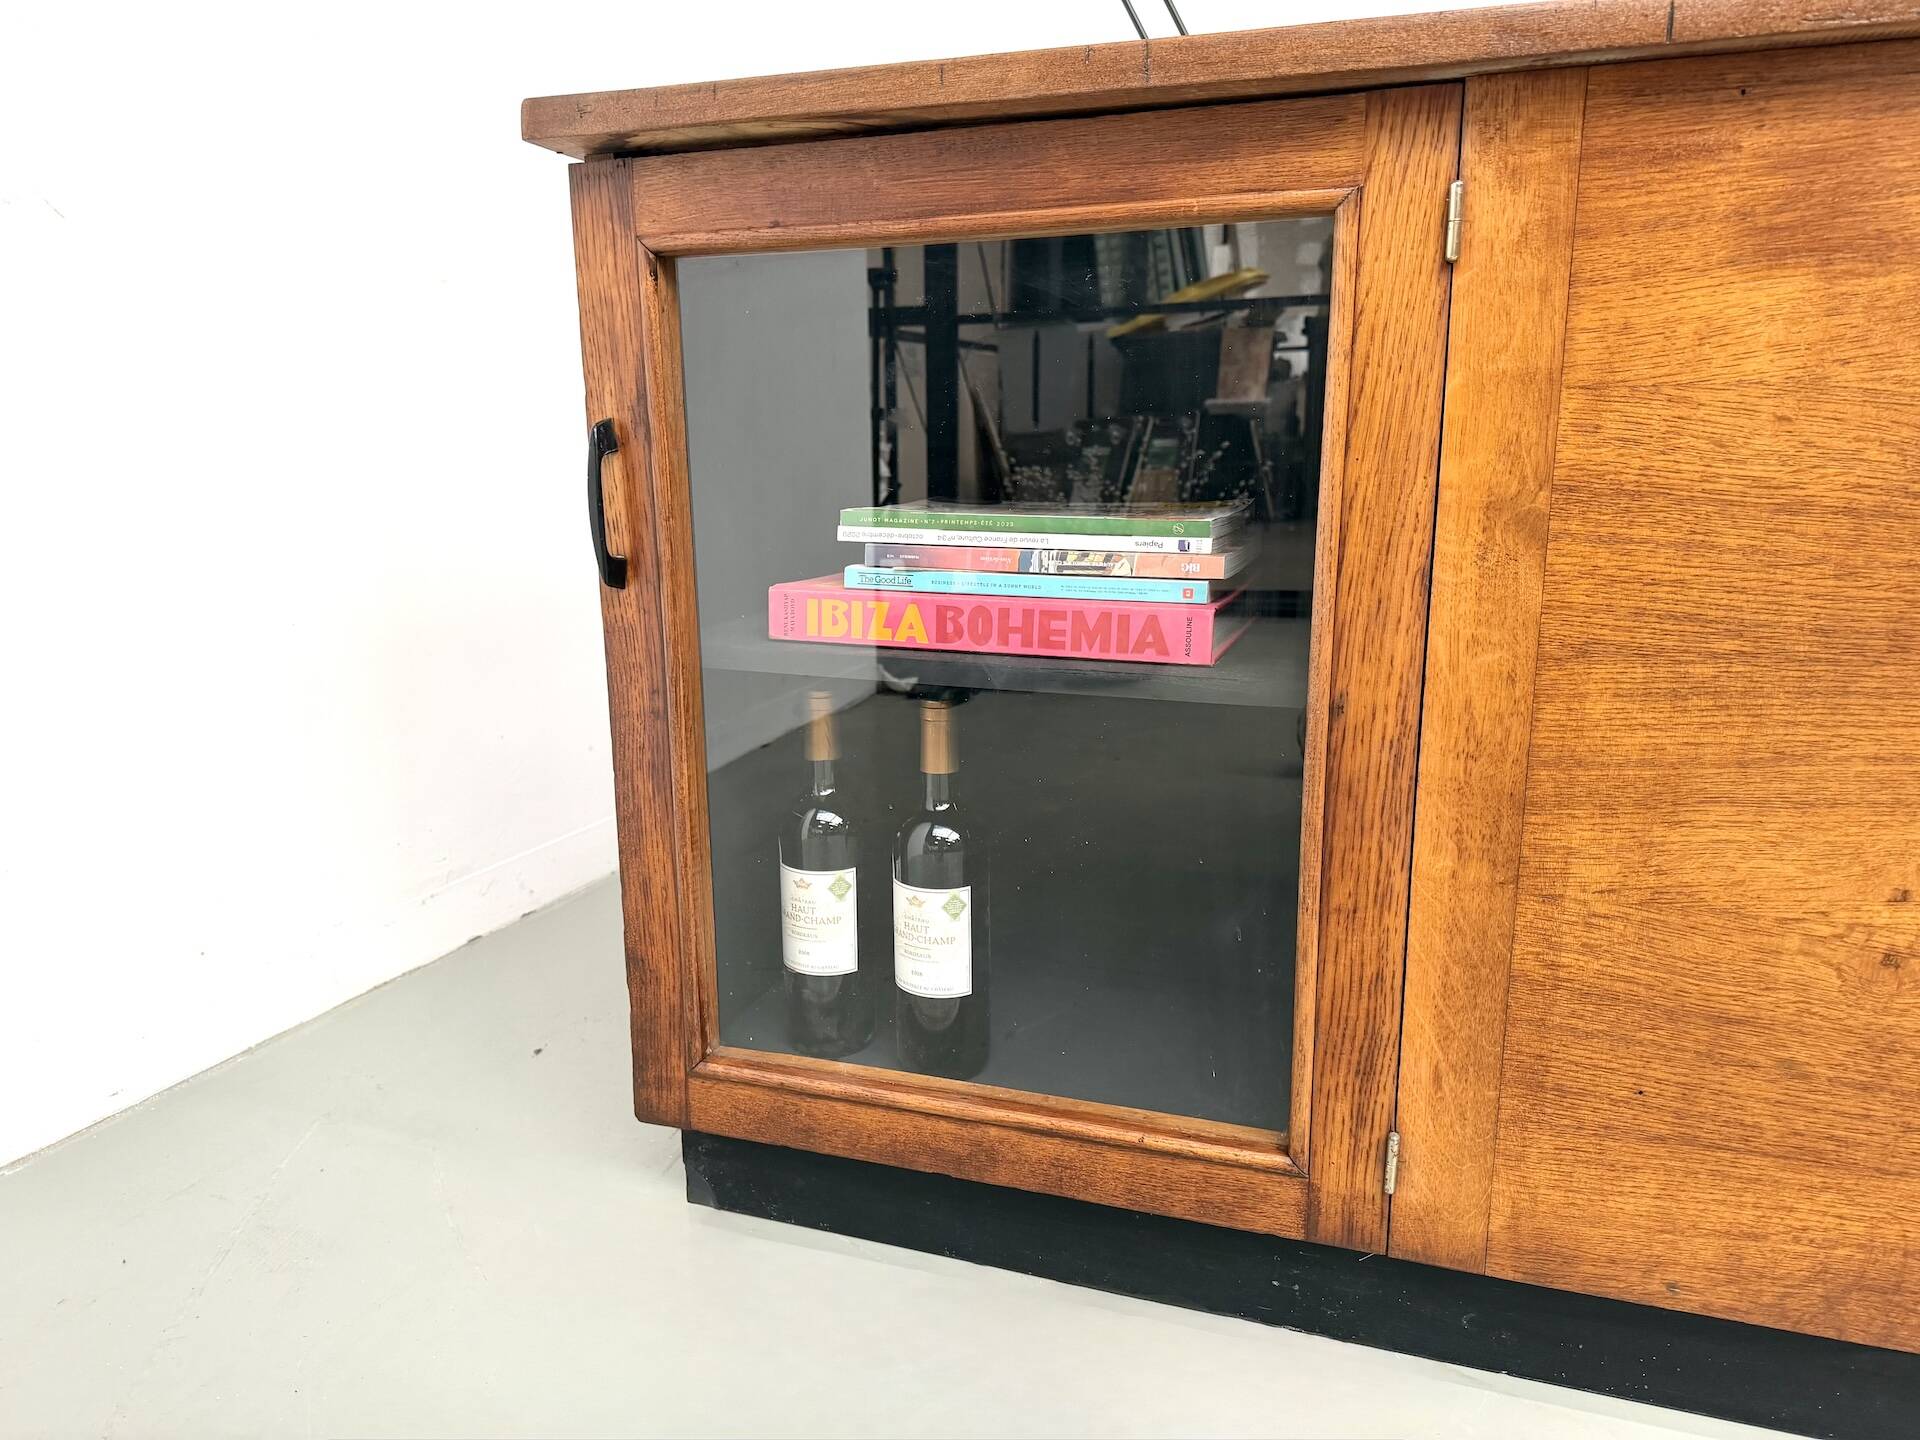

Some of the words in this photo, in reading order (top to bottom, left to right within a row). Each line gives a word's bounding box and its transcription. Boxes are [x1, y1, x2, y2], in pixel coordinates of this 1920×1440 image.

[884, 517, 919, 525] MAGAZINE
[983, 536, 1008, 544] France
[1134, 540, 1165, 549] Papiers
[859, 575, 874, 583] The
[874, 575, 896, 584] Good
[896, 576, 912, 585] Life
[806, 599, 929, 645] IBIZA
[935, 604, 1170, 657] BOHEMIA
[1184, 616, 1193, 658] ASSOULINE
[791, 903, 817, 915] HAUT
[904, 921, 930, 935] HAUT
